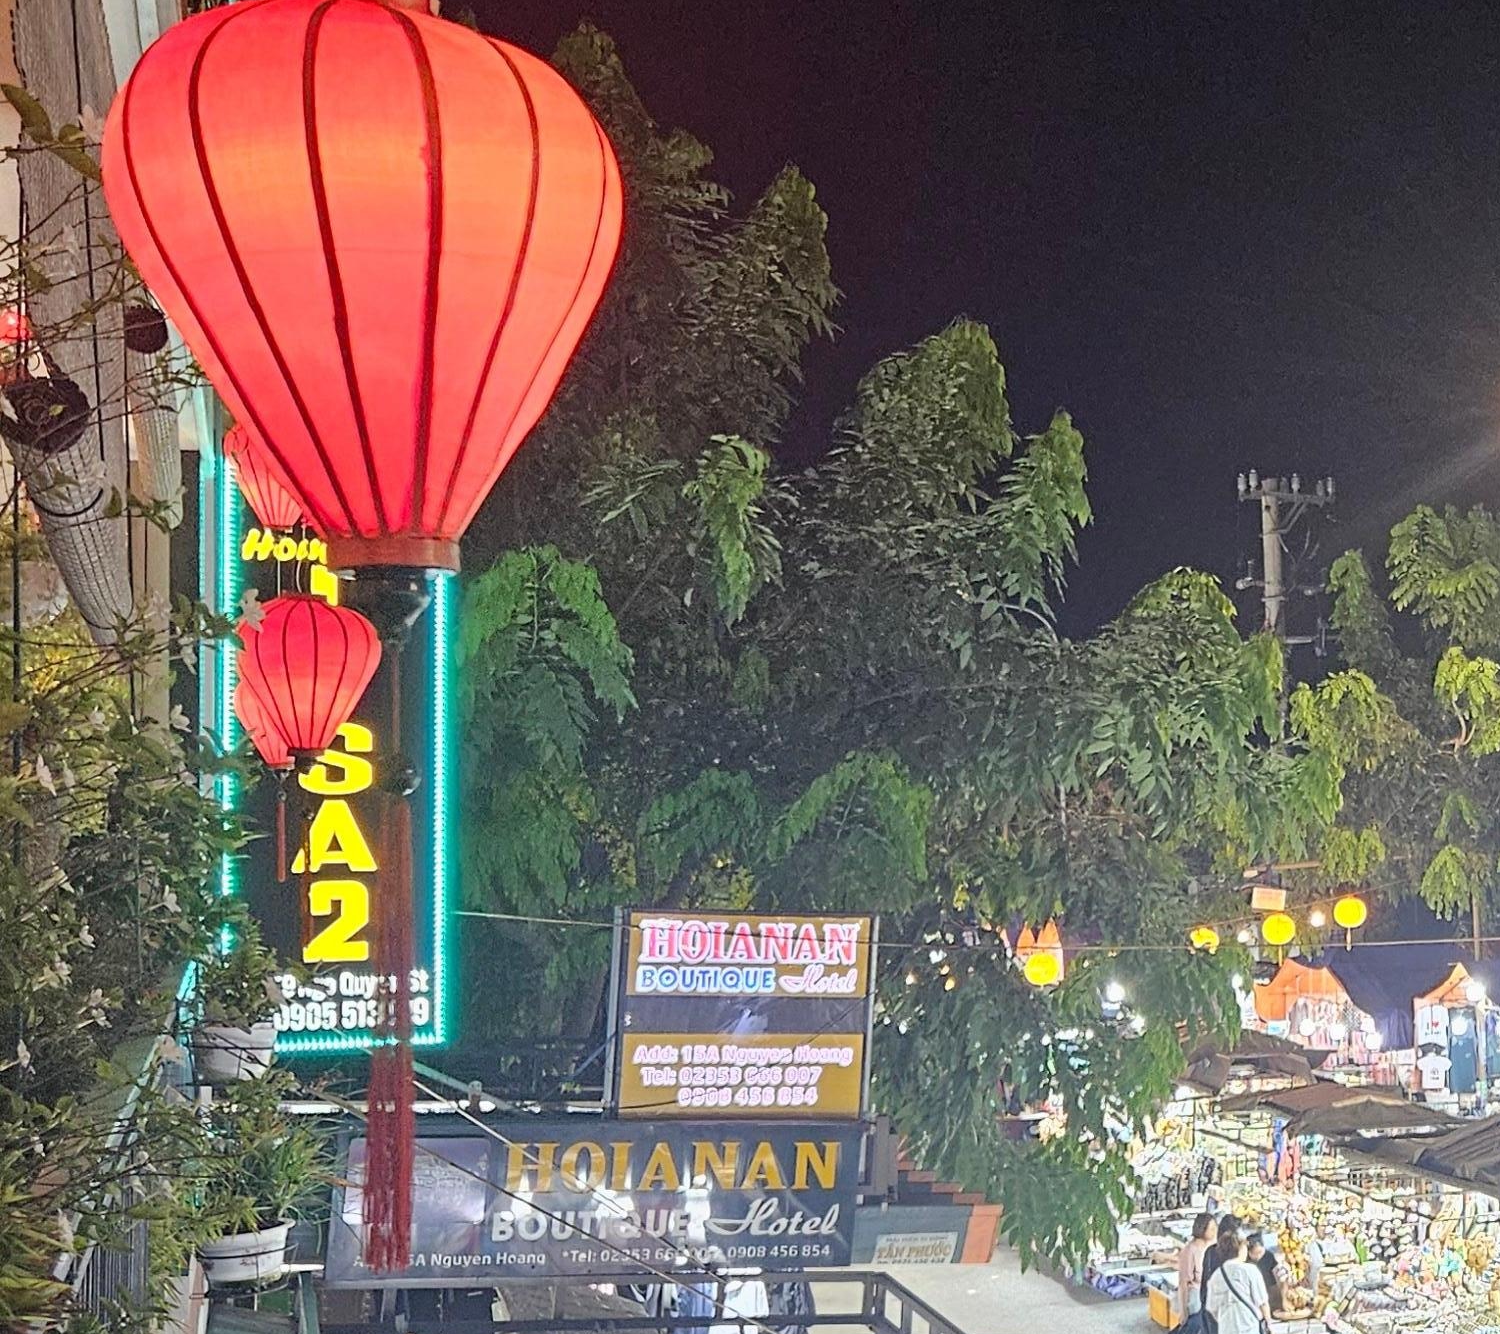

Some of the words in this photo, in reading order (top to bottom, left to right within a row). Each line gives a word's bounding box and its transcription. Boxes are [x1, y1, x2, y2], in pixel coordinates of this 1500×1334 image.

[638, 918, 861, 966] HOIANAN
[636, 965, 775, 994] BOUTIQUE
[778, 963, 859, 994] Hotel
[633, 1045, 678, 1064] Add:
[681, 1045, 720, 1063] 15A
[722, 1046, 793, 1066] Nguyen
[793, 1047, 854, 1067] Hoang
[641, 1067, 677, 1086] Tel:
[679, 1067, 742, 1086] 02353
[784, 1066, 823, 1086] 007
[505, 1140, 842, 1194] HOIANAN
[491, 1208, 690, 1243] BOUTIQUE
[705, 1196, 840, 1236] Hotel
[430, 1252, 492, 1268] Nguyen
[495, 1251, 546, 1266] Hoang
[727, 1245, 767, 1258] 0908
[769, 1244, 799, 1258] 456
[801, 1243, 831, 1257] 854
